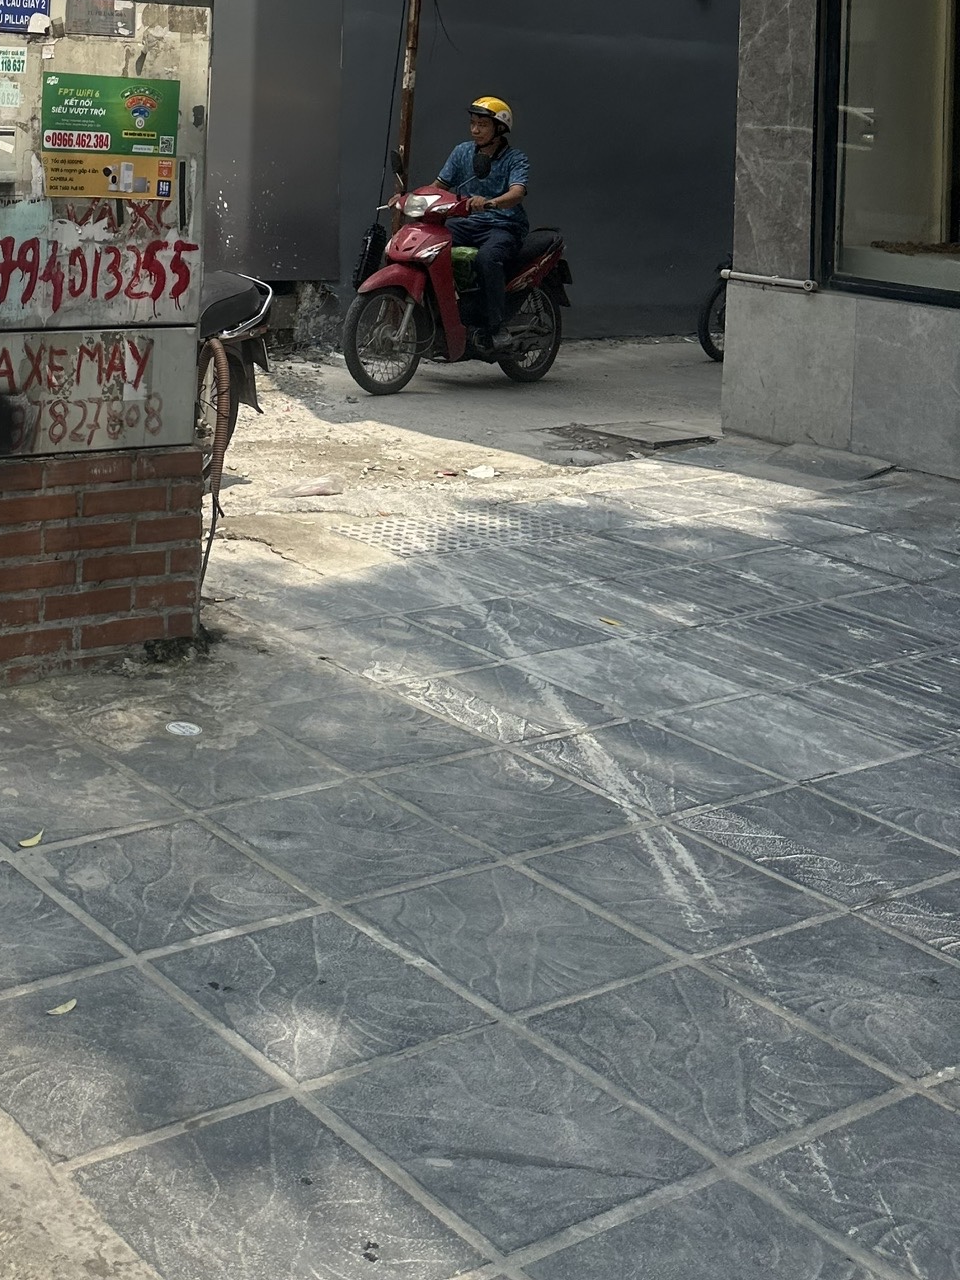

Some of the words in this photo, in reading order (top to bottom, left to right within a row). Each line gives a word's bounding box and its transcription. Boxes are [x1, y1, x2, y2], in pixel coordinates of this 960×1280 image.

[41, 0, 46, 9] 2
[58, 87, 74, 96] FPT
[95, 90, 100, 98] 6
[64, 96, 79, 106] KẾT
[51, 104, 67, 114] SIÊU
[90, 108, 106, 117] TRỘI
[51, 131, 109, 149] 0966.462.384
